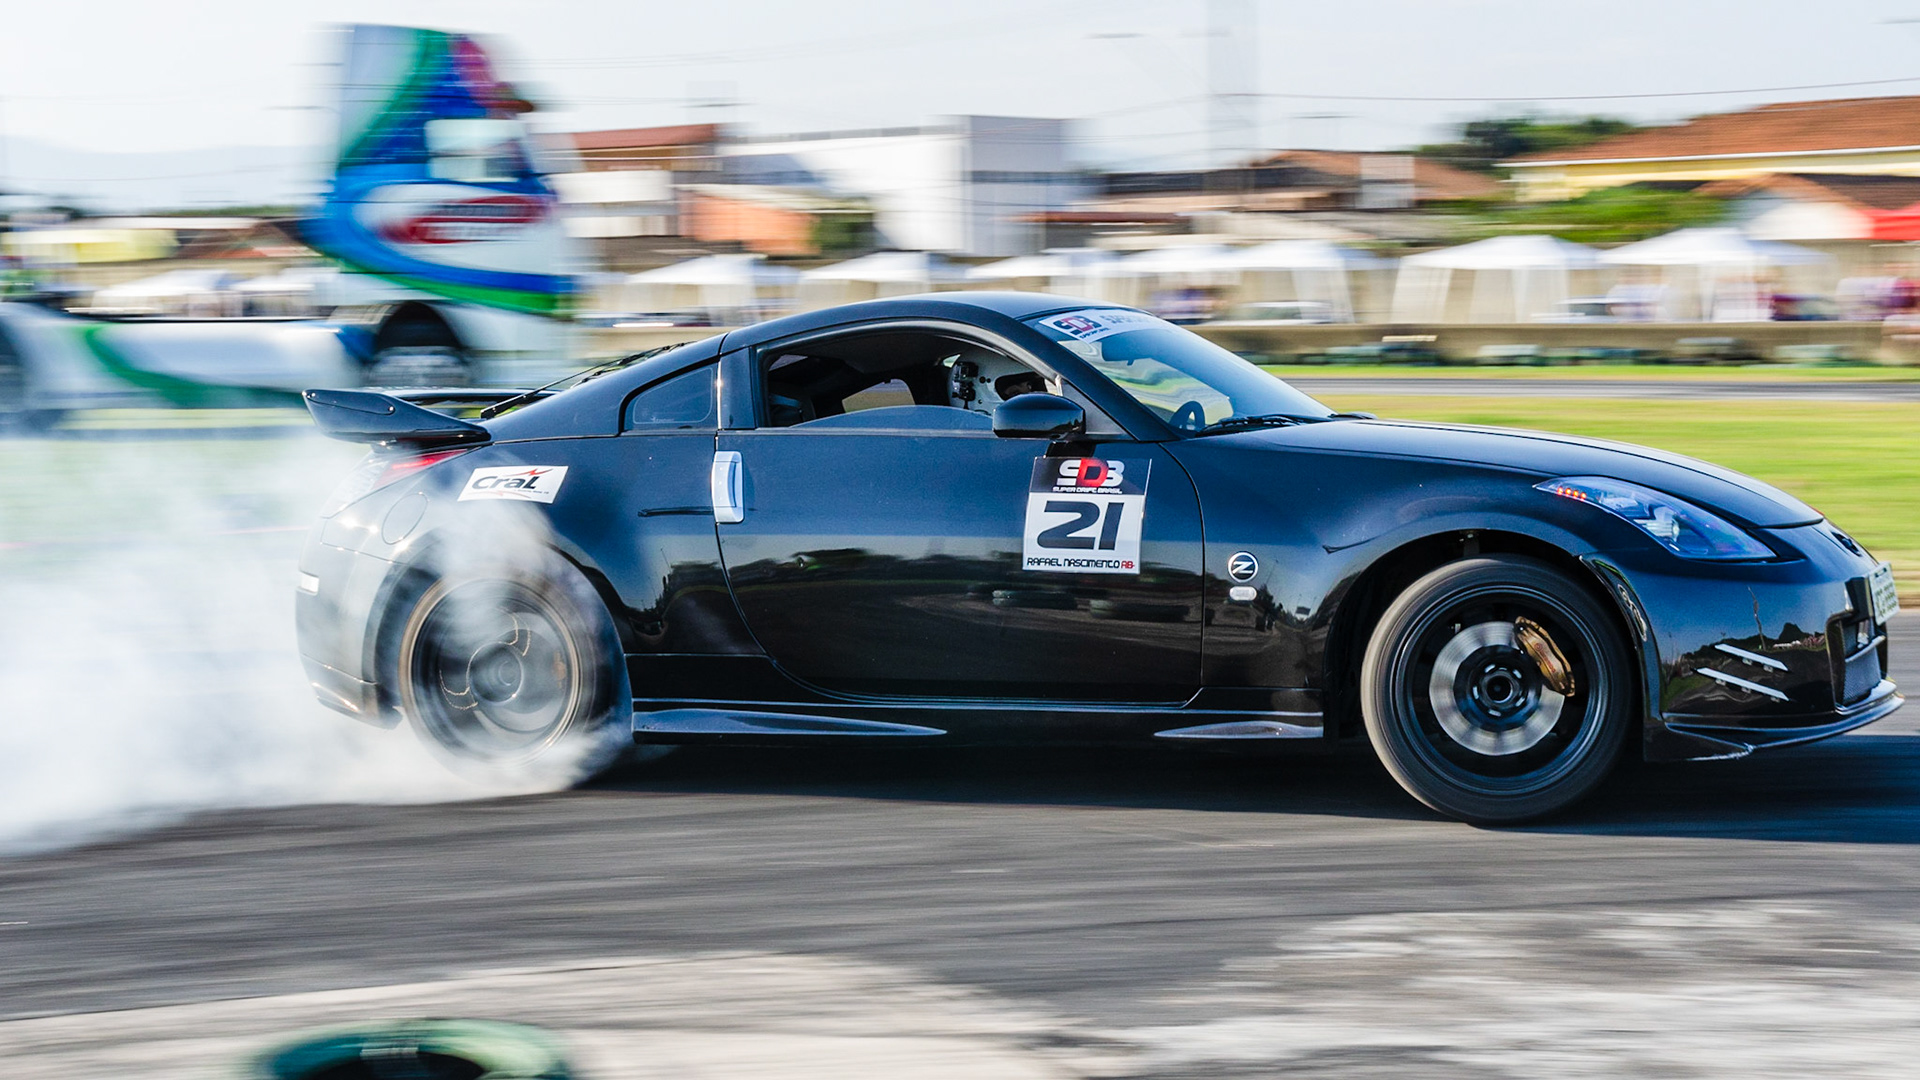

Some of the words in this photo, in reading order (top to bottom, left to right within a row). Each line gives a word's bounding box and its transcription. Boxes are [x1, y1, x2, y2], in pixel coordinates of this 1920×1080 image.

[1056, 458, 1125, 487] SDB
[1037, 501, 1125, 551] 21
[1027, 557, 1062, 567] RAFAEL
[1063, 558, 1120, 569] NASCIMENTO
